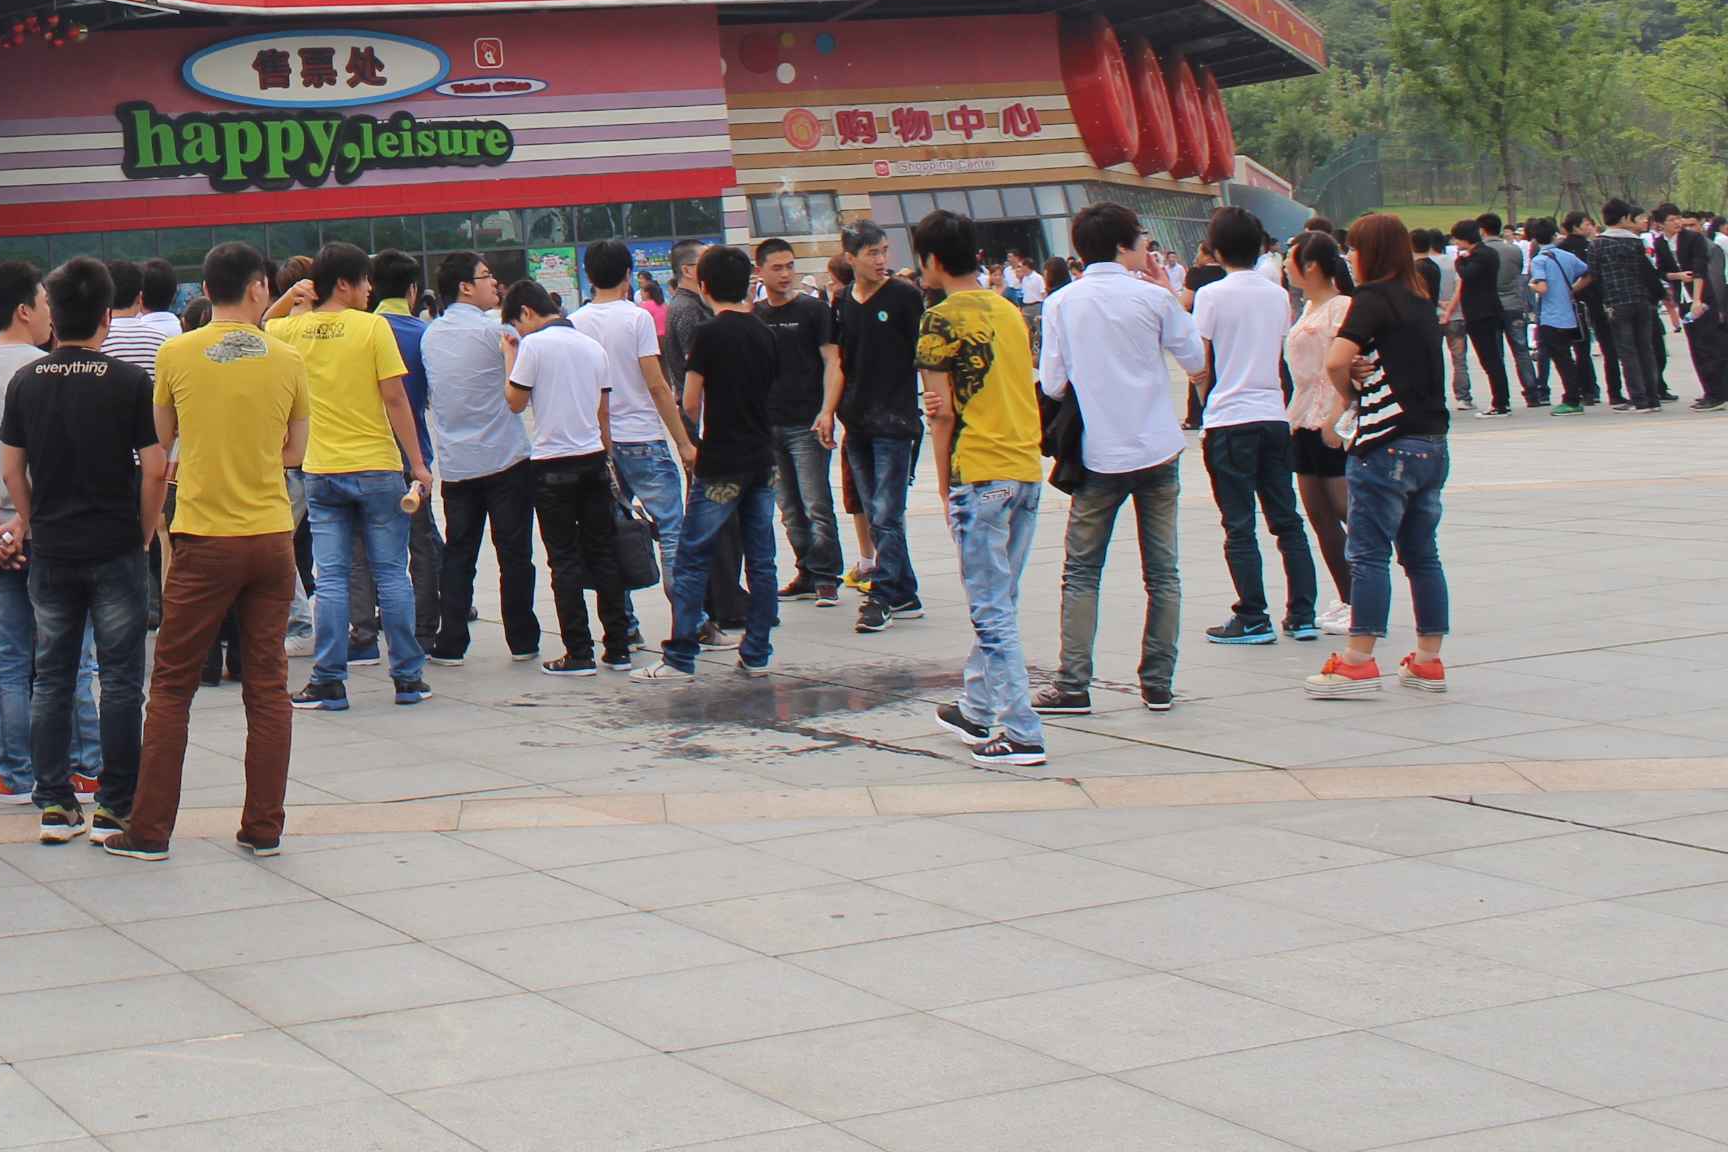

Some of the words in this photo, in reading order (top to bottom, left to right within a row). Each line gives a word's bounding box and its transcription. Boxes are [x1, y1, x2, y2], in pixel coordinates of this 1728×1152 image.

[252, 46, 387, 90] 售票处
[835, 103, 1041, 145] 购物中心
[35, 360, 109, 377] everything
